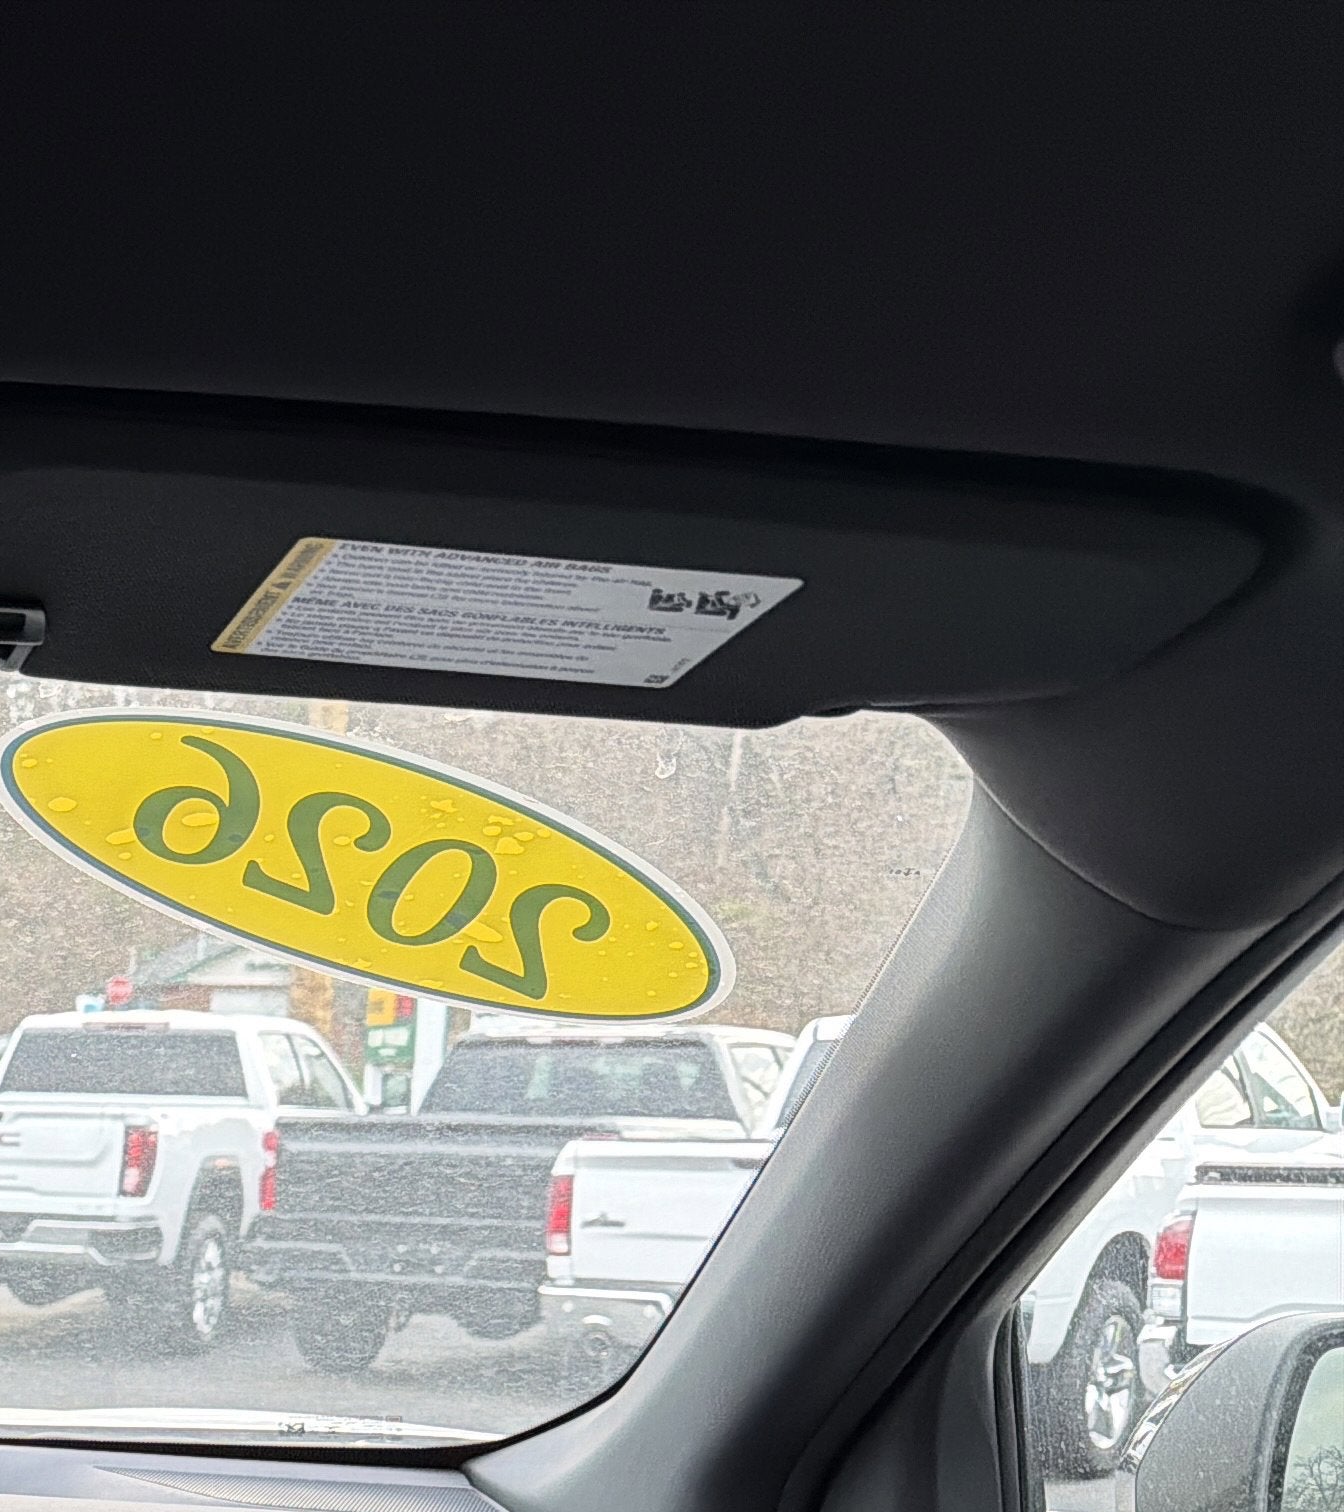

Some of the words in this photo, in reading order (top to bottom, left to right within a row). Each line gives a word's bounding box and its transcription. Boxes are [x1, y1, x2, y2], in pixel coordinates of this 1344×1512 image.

[338, 543, 387, 554] EVEN
[387, 547, 433, 558] WITH
[435, 550, 528, 567] ADVANCED
[530, 560, 561, 570] AIR
[561, 562, 612, 574] BAGS
[341, 600, 381, 609] AVEC
[384, 603, 417, 614] DES
[417, 606, 459, 617] SACS
[561, 619, 666, 635] INTELLIGENTS
